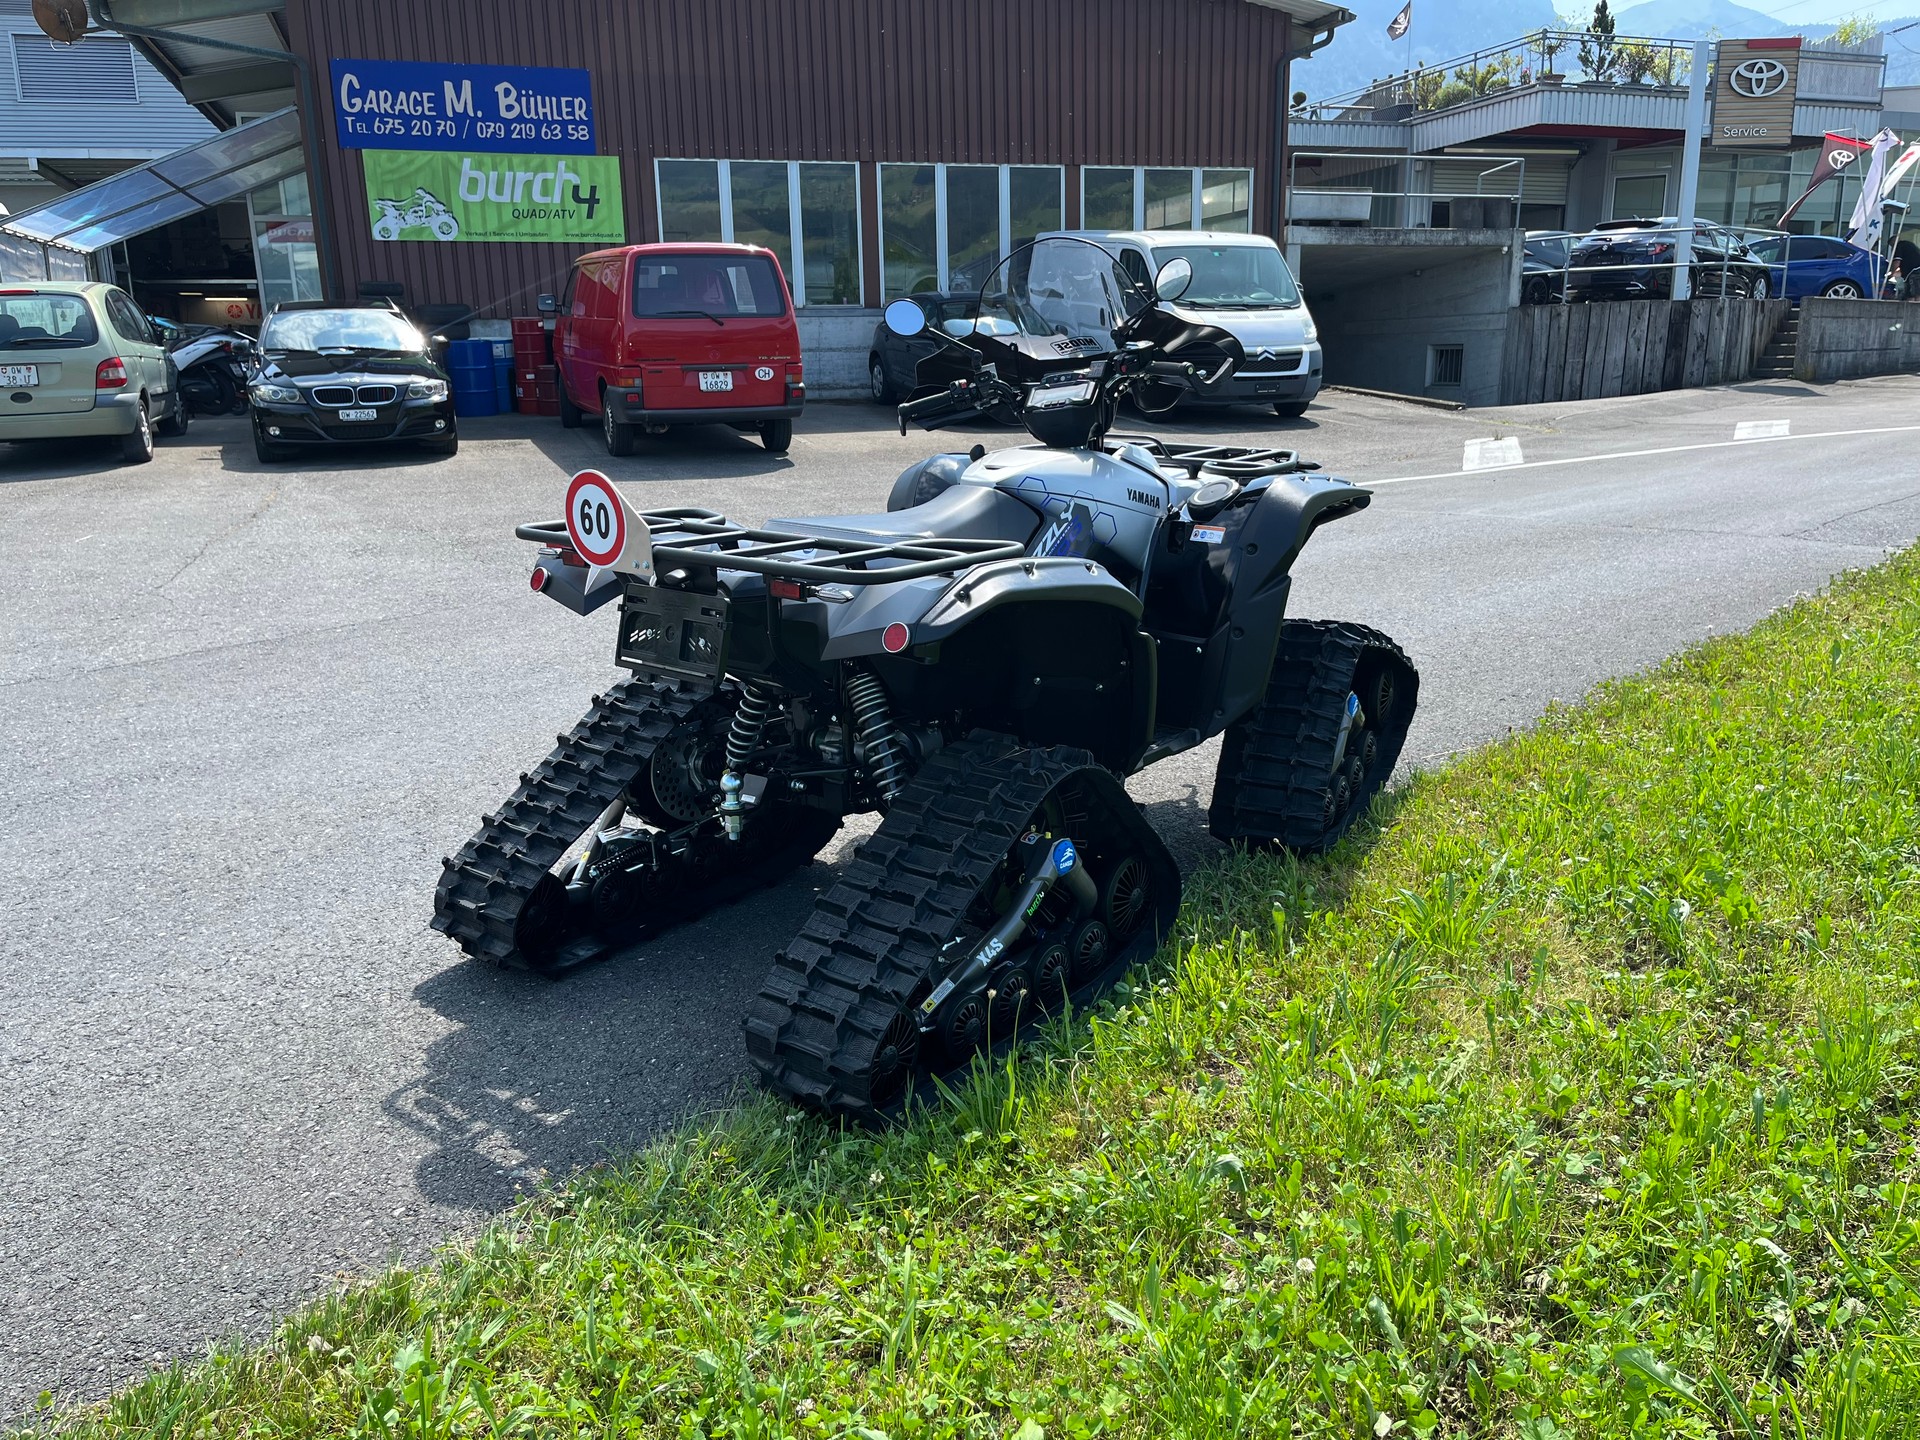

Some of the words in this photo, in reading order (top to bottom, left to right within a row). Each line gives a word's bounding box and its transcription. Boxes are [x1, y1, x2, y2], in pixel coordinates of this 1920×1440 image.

[340, 73, 436, 116] GARAGE
[443, 79, 483, 118] M.
[373, 117, 405, 135] 675
[411, 119, 432, 137] 20
[435, 120, 456, 137] 70
[462, 119, 470, 139] /
[476, 122, 505, 139] 079
[511, 123, 536, 140] 219
[541, 123, 563, 141] 63
[567, 125, 590, 141] 58
[1723, 125, 1767, 137] Service
[512, 208, 576, 220] QUAD/ATV
[267, 228, 313, 237] DUCAT
[11, 366, 22, 374] OW
[710, 372, 720, 380] OW
[757, 368, 771, 379] CH
[704, 380, 729, 390] 16829
[1127, 487, 1161, 509] YAMAHA
[579, 498, 610, 540] 60
[1031, 497, 1075, 557] ZZLY
[976, 937, 1004, 967] X4S
